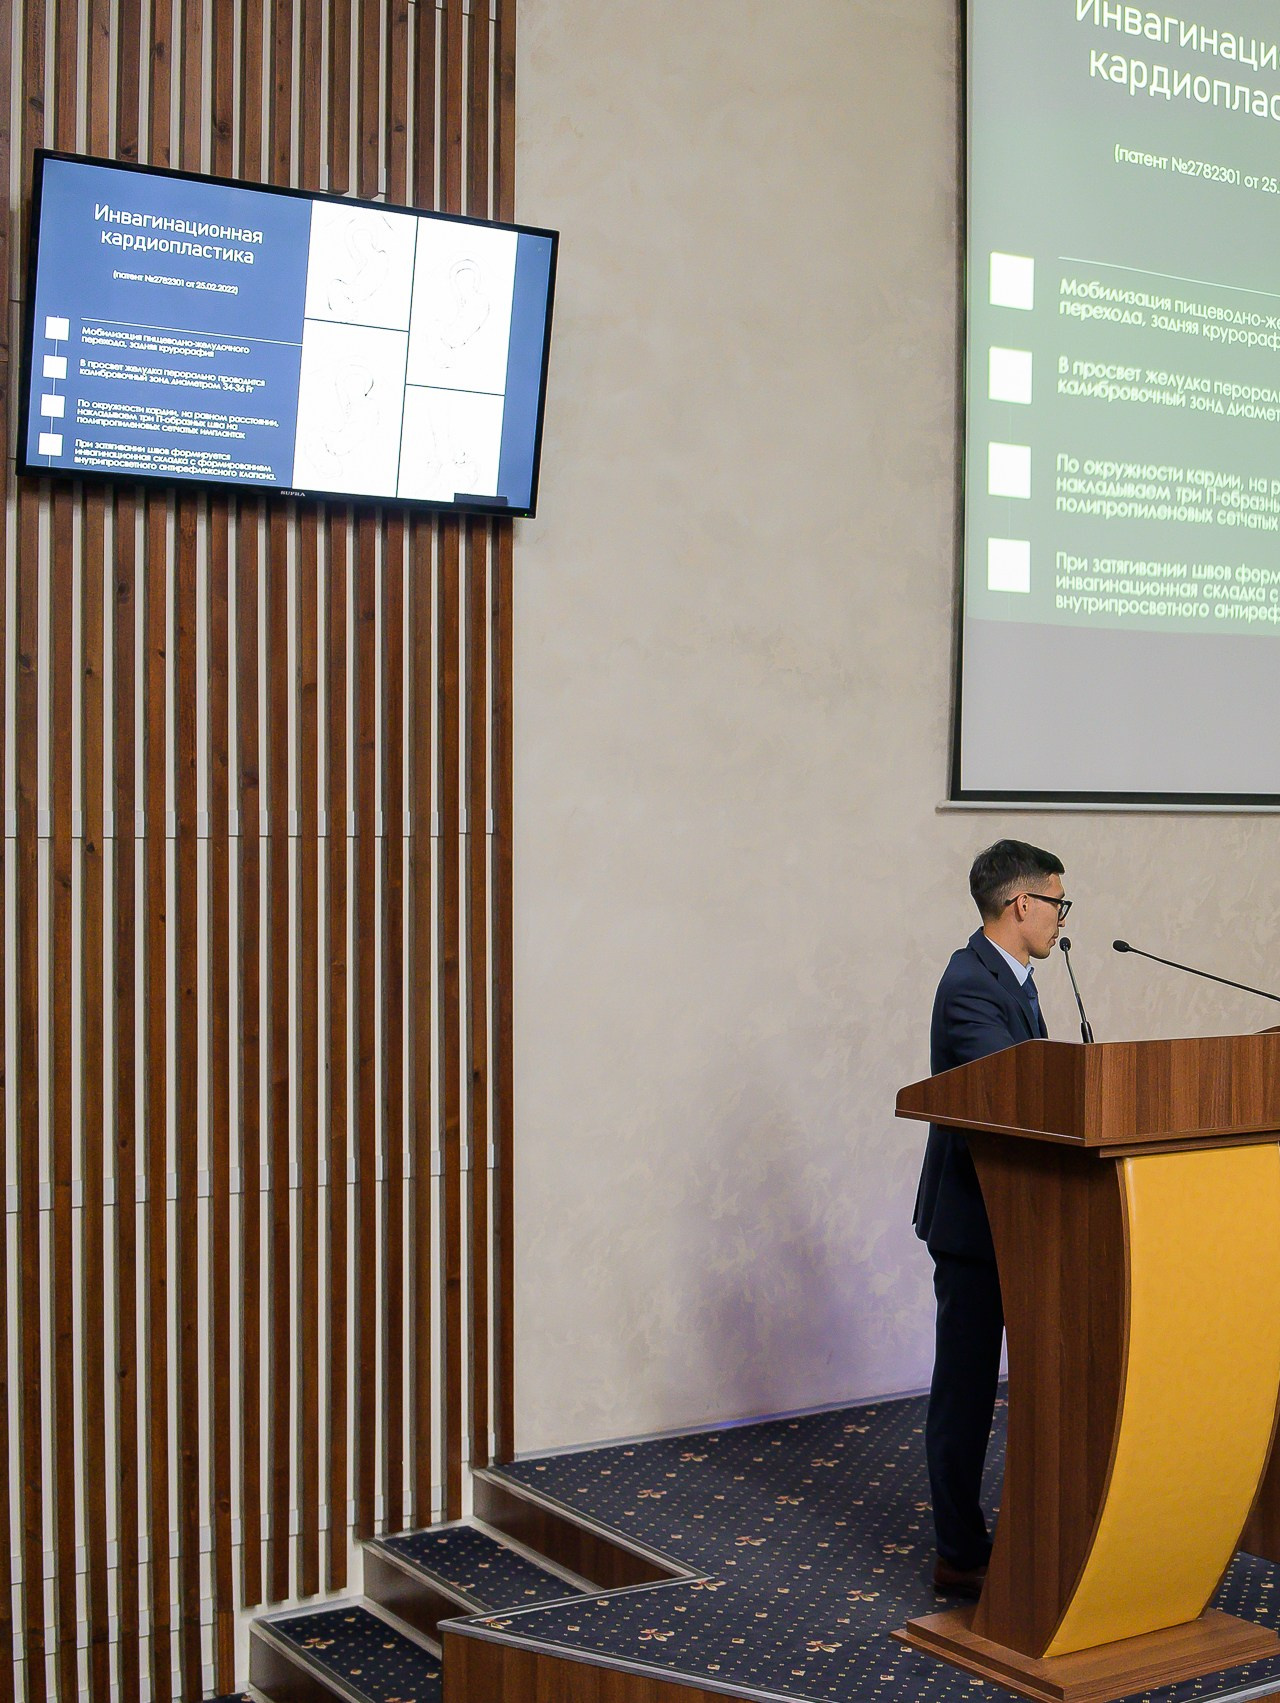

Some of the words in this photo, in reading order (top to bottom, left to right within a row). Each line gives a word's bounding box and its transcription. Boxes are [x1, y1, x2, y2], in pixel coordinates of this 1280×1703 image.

[1114, 144, 1169, 170] (патент
[1171, 156, 1240, 186] №2782301
[1244, 175, 1259, 189] от
[94, 203, 264, 245] Инвагинационная
[100, 230, 255, 265] кардиопластика
[113, 270, 144, 282] (патент
[144, 274, 185, 287] №2782301
[186, 280, 195, 288] от
[196, 281, 239, 295] 25.02.2022)
[1059, 278, 1171, 312] Мобилизация
[1059, 299, 1147, 327] перехода,
[1151, 313, 1199, 336] задняя
[81, 326, 142, 341] Мобилизация
[143, 334, 250, 354] пищеводно-желудочного
[81, 335, 127, 349] перехода,
[129, 341, 158, 352] задняя
[158, 344, 215, 358] крурорафия
[79, 367, 147, 382] калибровочный
[149, 375, 170, 385] зонд
[170, 378, 221, 391] диаметром
[222, 383, 244, 393] 34-36
[245, 385, 254, 394] Fr
[87, 361, 124, 371] просвет
[124, 364, 163, 376] желудка
[164, 368, 216, 382] перорально
[217, 375, 266, 387] проводится
[1058, 356, 1069, 375] В
[1072, 360, 1141, 383] просвет
[1145, 371, 1211, 397] желудка
[1057, 378, 1186, 408] калибровочный
[1189, 398, 1224, 415] зонд
[76, 416, 160, 431] полипропиленовых
[162, 424, 198, 435] сетчатых
[200, 428, 246, 440] имплантах
[77, 399, 90, 408] По
[91, 402, 145, 414] окружности
[146, 406, 179, 418] кардии,
[181, 410, 193, 418] на
[194, 411, 227, 422] равном
[228, 415, 279, 428] расстоянии,
[75, 438, 93, 449] При
[95, 442, 146, 453] затягивании
[147, 447, 170, 456] швов
[171, 447, 231, 461] формируется
[1056, 453, 1080, 475] По
[1083, 458, 1184, 484] окружности
[1186, 466, 1244, 492] кардии,
[1248, 475, 1268, 494] на
[1056, 475, 1171, 502] накладываем
[1175, 486, 1202, 508] три
[1055, 495, 1213, 524] полипропиленовых
[1216, 509, 1279, 532] сетчатых
[1055, 551, 1088, 574] При
[1092, 556, 1187, 579] затягивании
[1192, 562, 1232, 581] швов
[1055, 574, 1198, 600] инвагинационная
[1202, 583, 1266, 602] складка
[1055, 595, 1210, 621] внутрипросветного
